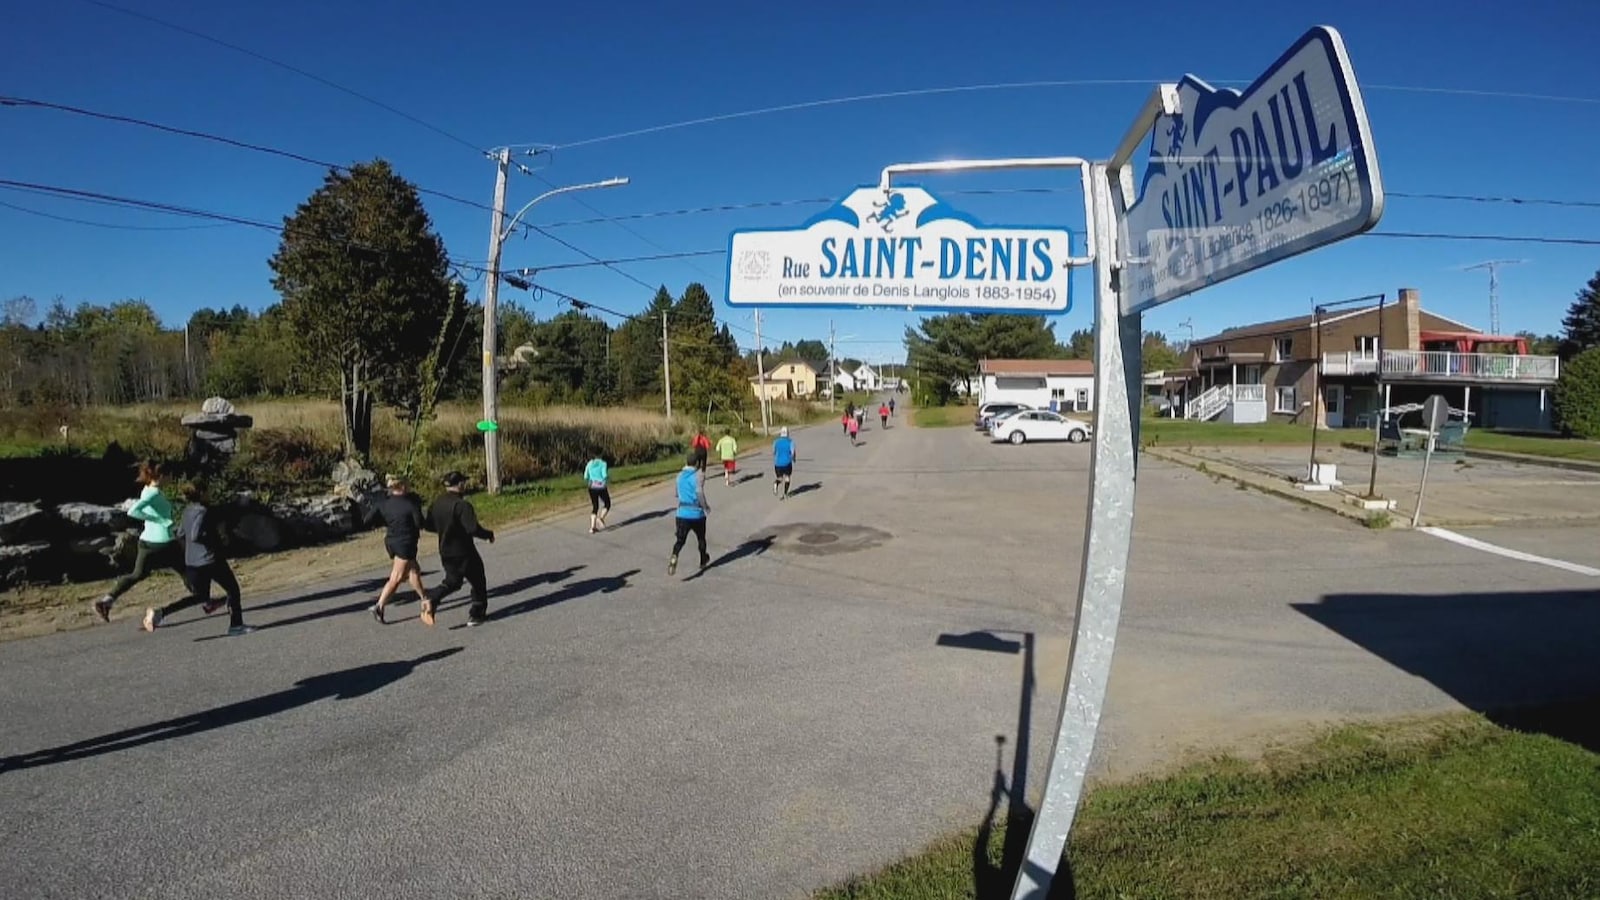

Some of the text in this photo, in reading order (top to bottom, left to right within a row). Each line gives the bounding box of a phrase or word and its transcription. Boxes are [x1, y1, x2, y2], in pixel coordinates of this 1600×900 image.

[1161, 70, 1337, 248] SAINT-PAUL
[1256, 166, 1352, 236] 1826-1897)
[782, 236, 1053, 282] Rue SAINT-DENIS
[778, 284, 1057, 304] (en souvenir de Denis Langlois 1883-1954)
